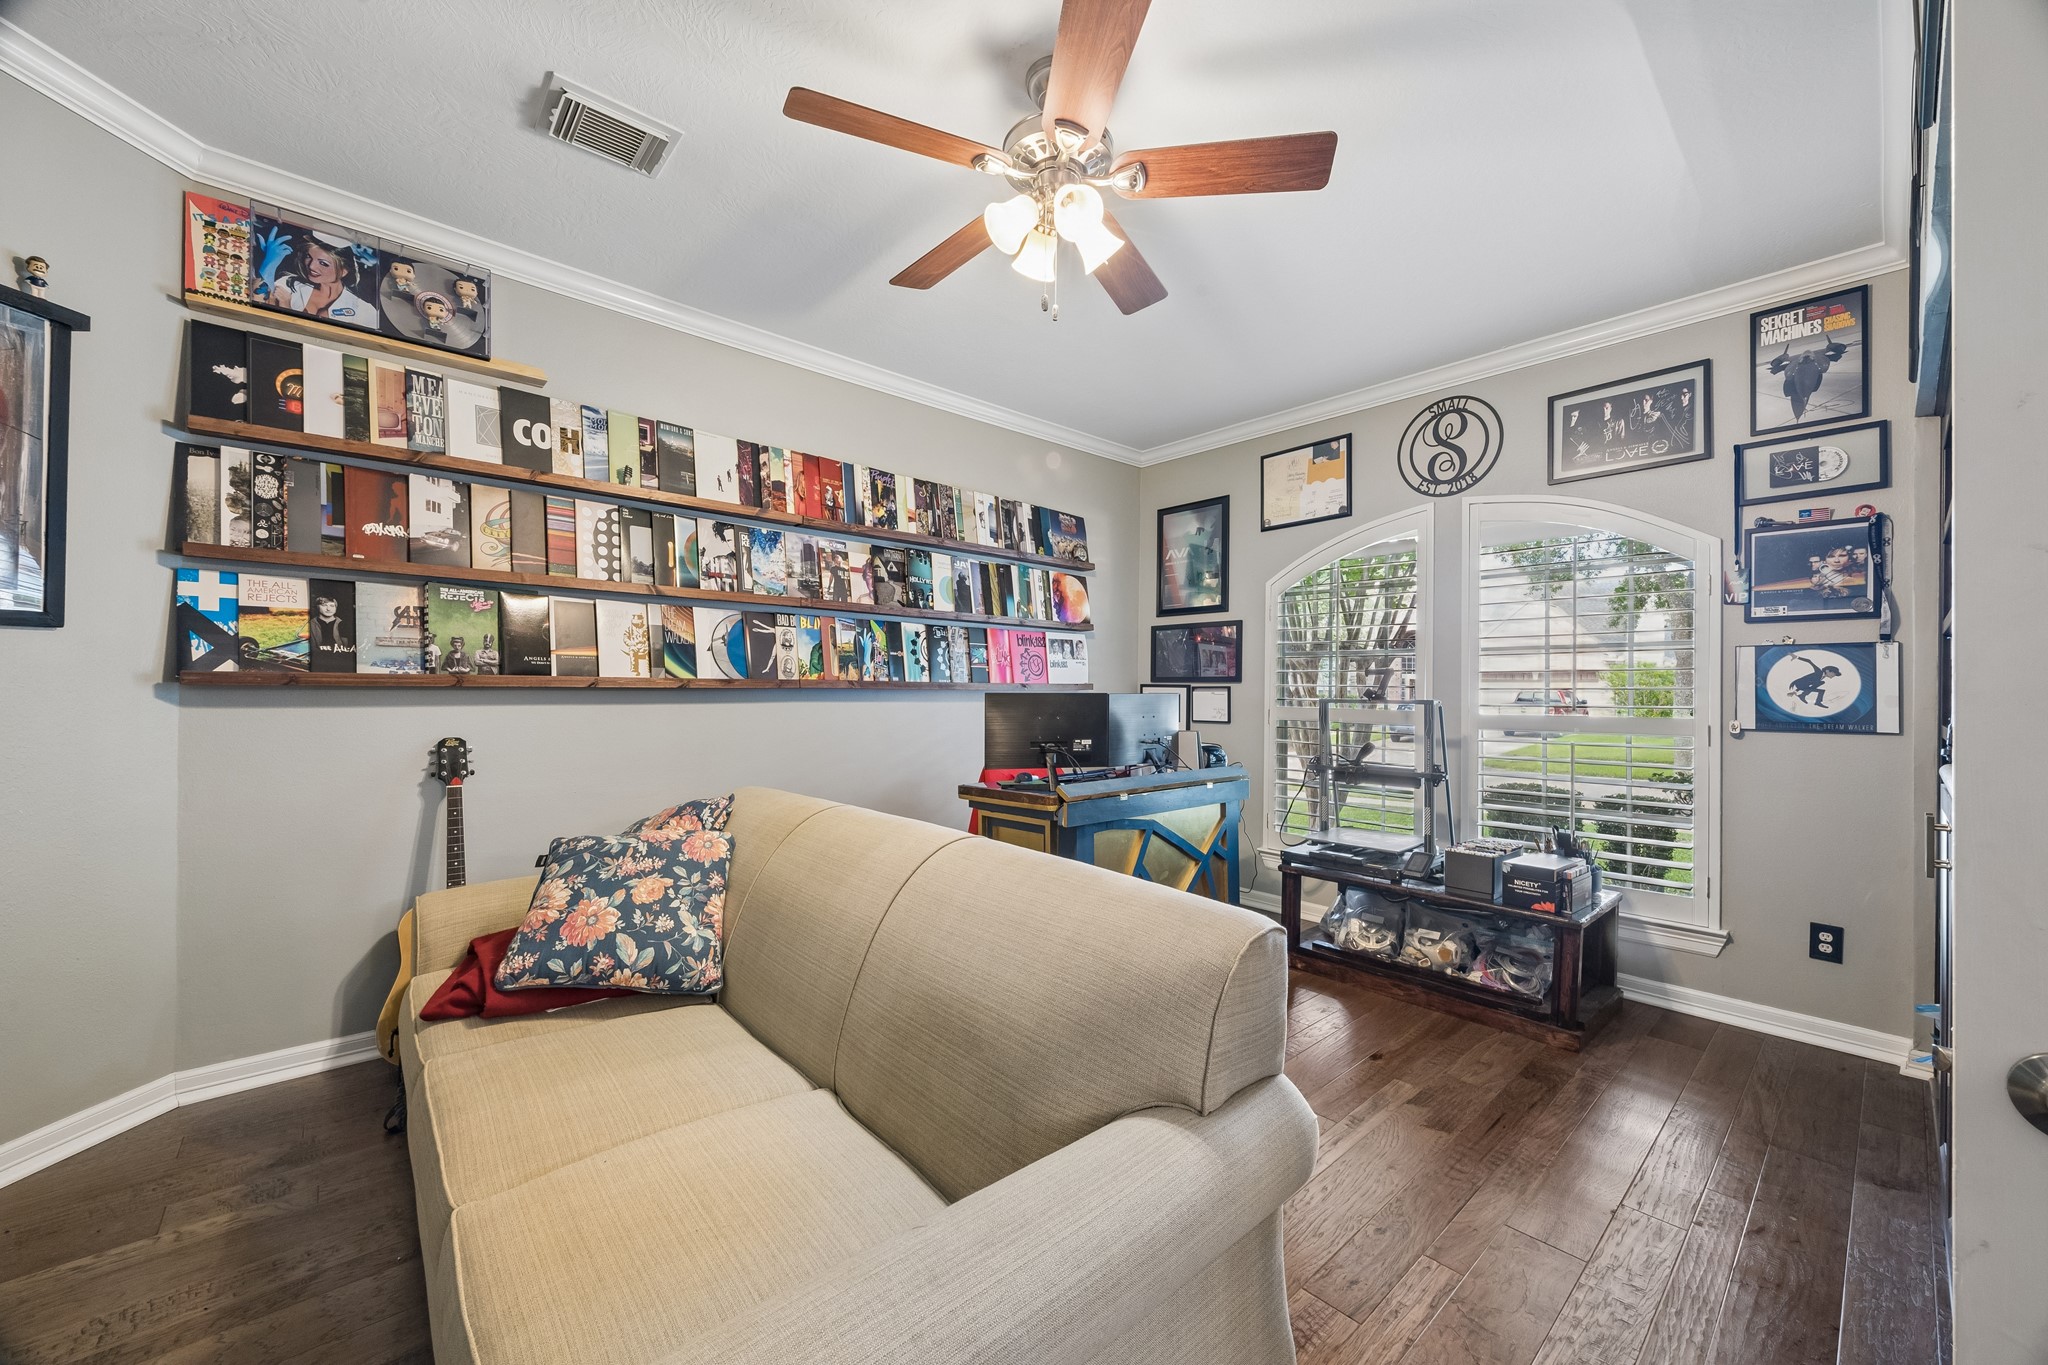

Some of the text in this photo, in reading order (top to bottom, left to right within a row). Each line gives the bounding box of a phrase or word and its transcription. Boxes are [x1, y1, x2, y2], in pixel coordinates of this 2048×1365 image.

[1760, 308, 1805, 333] SEKRET
[1760, 319, 1822, 347] MACHINES
[1428, 398, 1469, 418] SMALL
[189, 447, 204, 455] Bon
[1448, 473, 1478, 494] 2018
[247, 579, 296, 590] THE ALL-
[247, 587, 298, 596] AMERICAN
[440, 591, 485, 602] REJECTS
[247, 593, 298, 604] REJECTS
[1724, 592, 1749, 604] VIP
[777, 613, 789, 626] BAD
